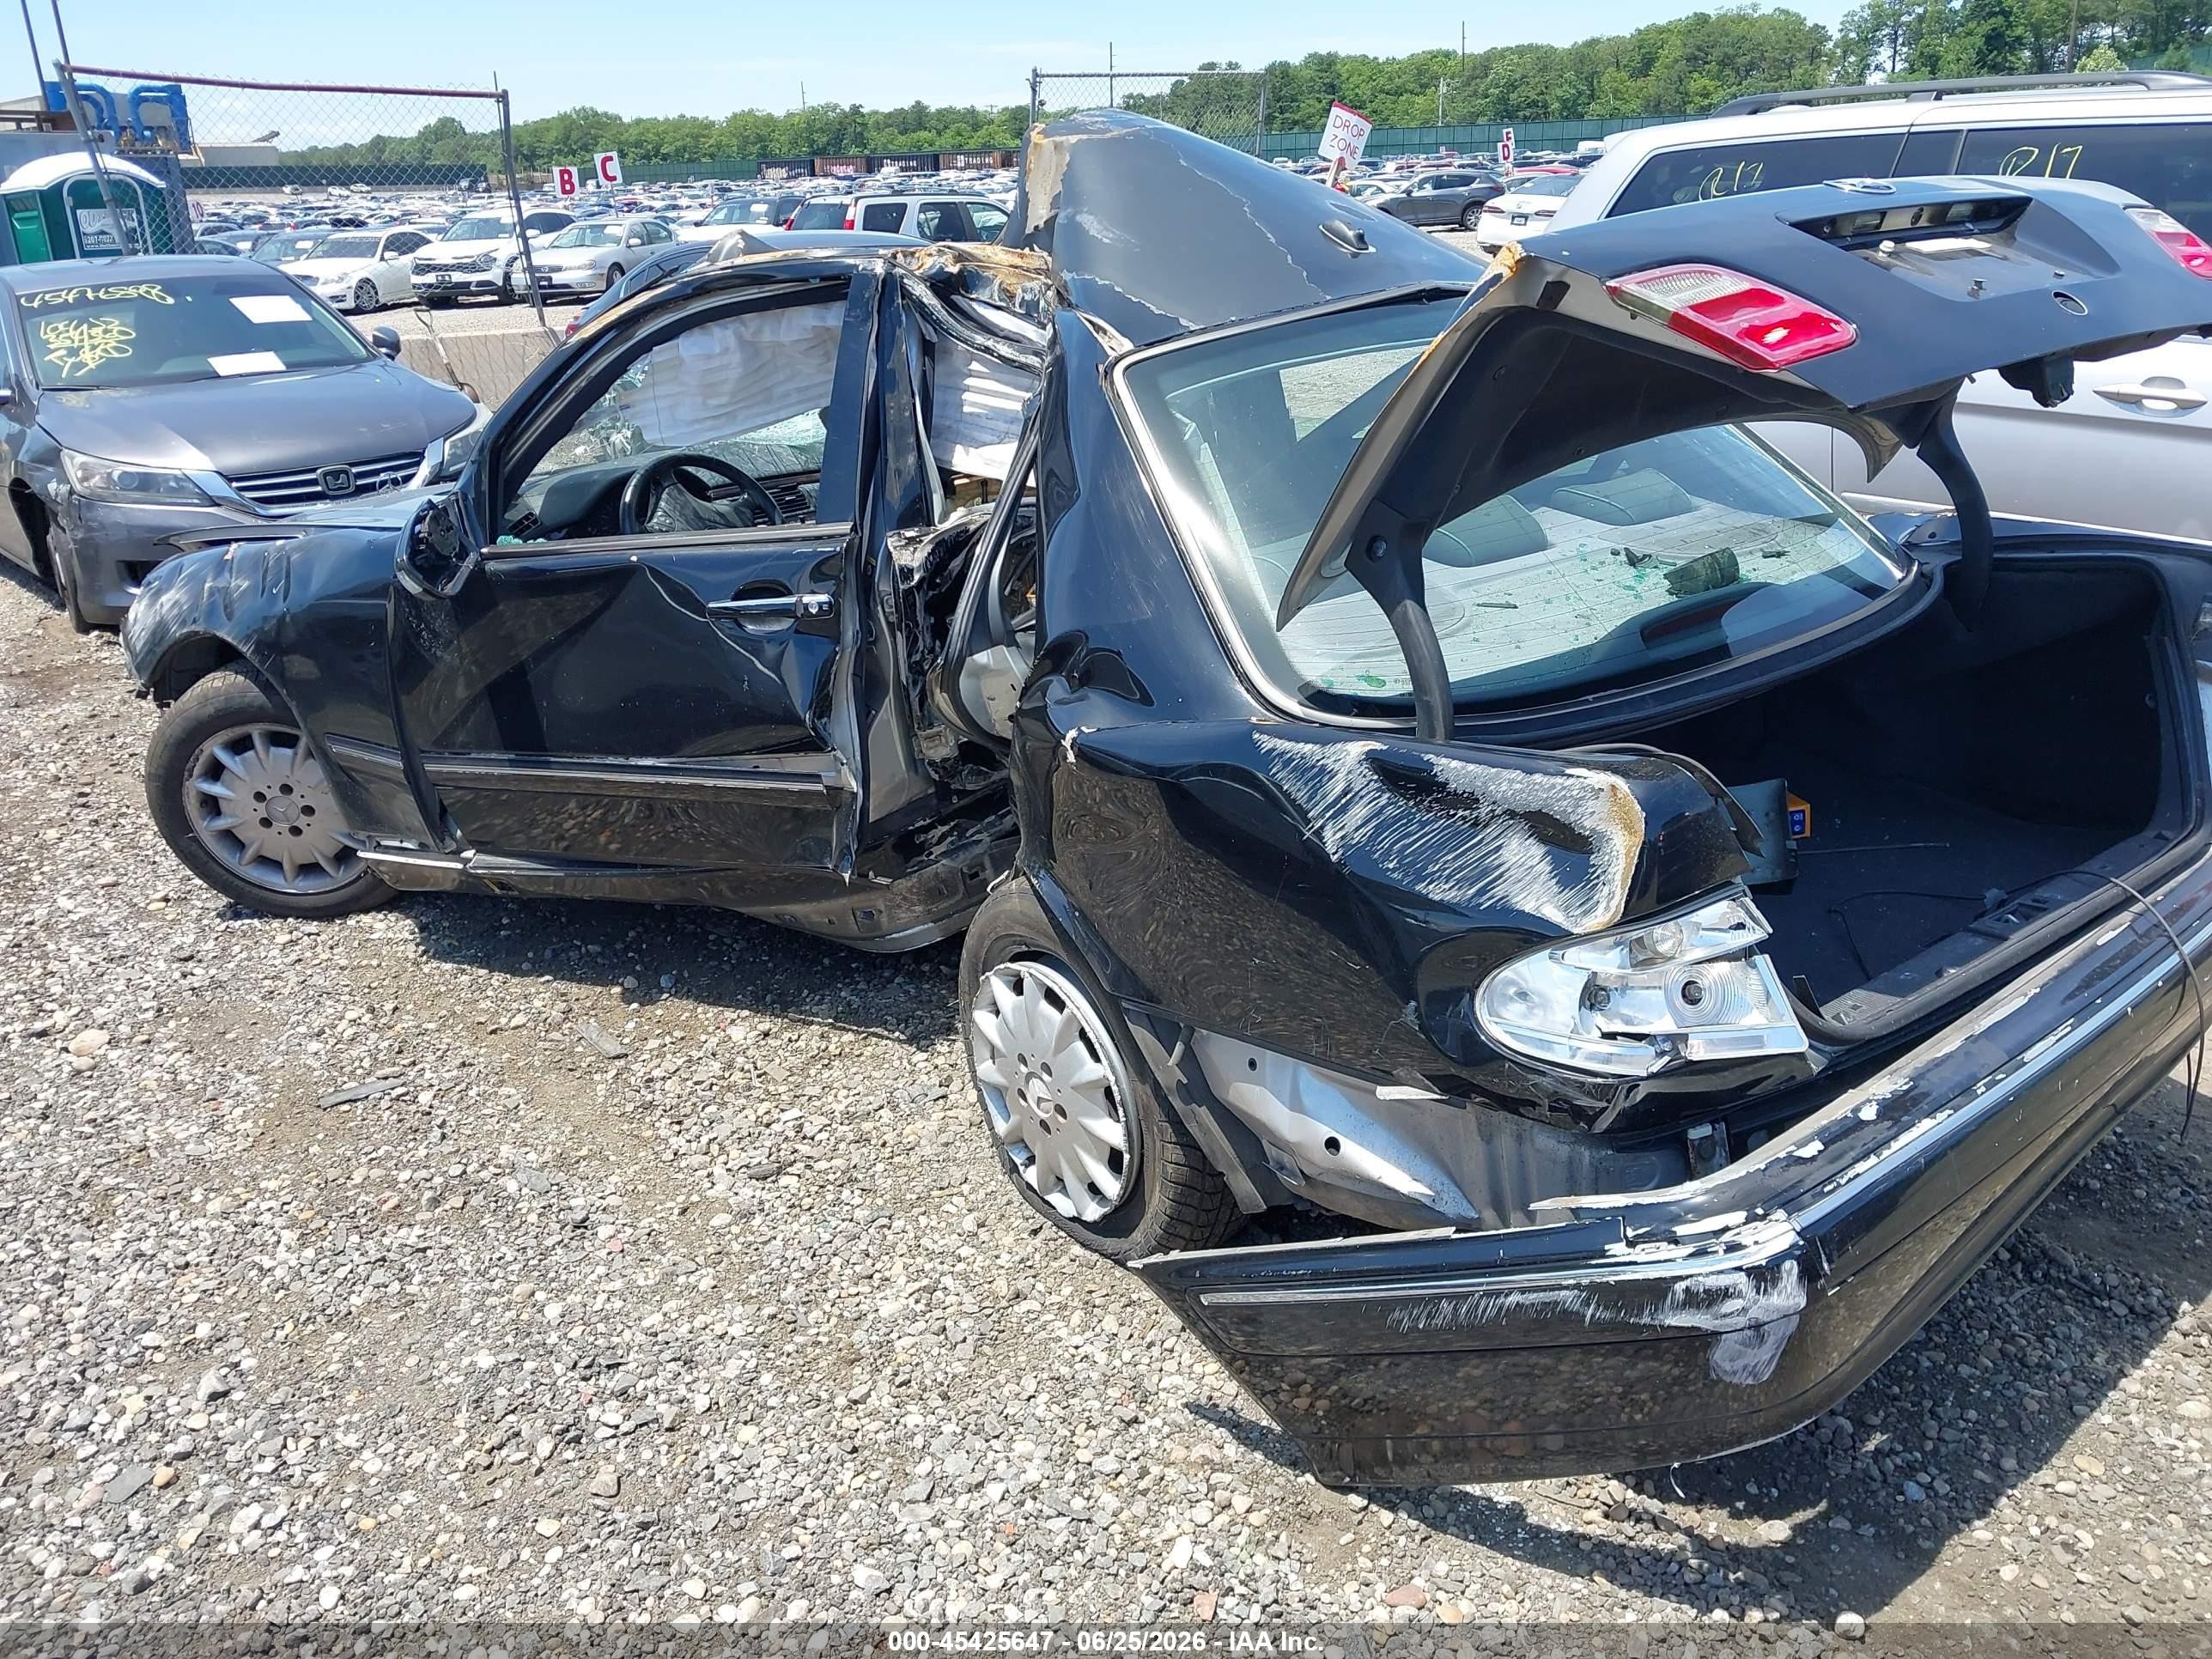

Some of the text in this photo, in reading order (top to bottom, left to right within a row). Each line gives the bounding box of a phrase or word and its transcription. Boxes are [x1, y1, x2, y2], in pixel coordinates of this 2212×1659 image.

[1333, 115, 1365, 140] DROP
[1329, 133, 1359, 160] ZONE
[1502, 143, 1510, 161] D
[559, 168, 575, 195] B
[601, 155, 617, 182] C
[191, 201, 204, 219] 10
